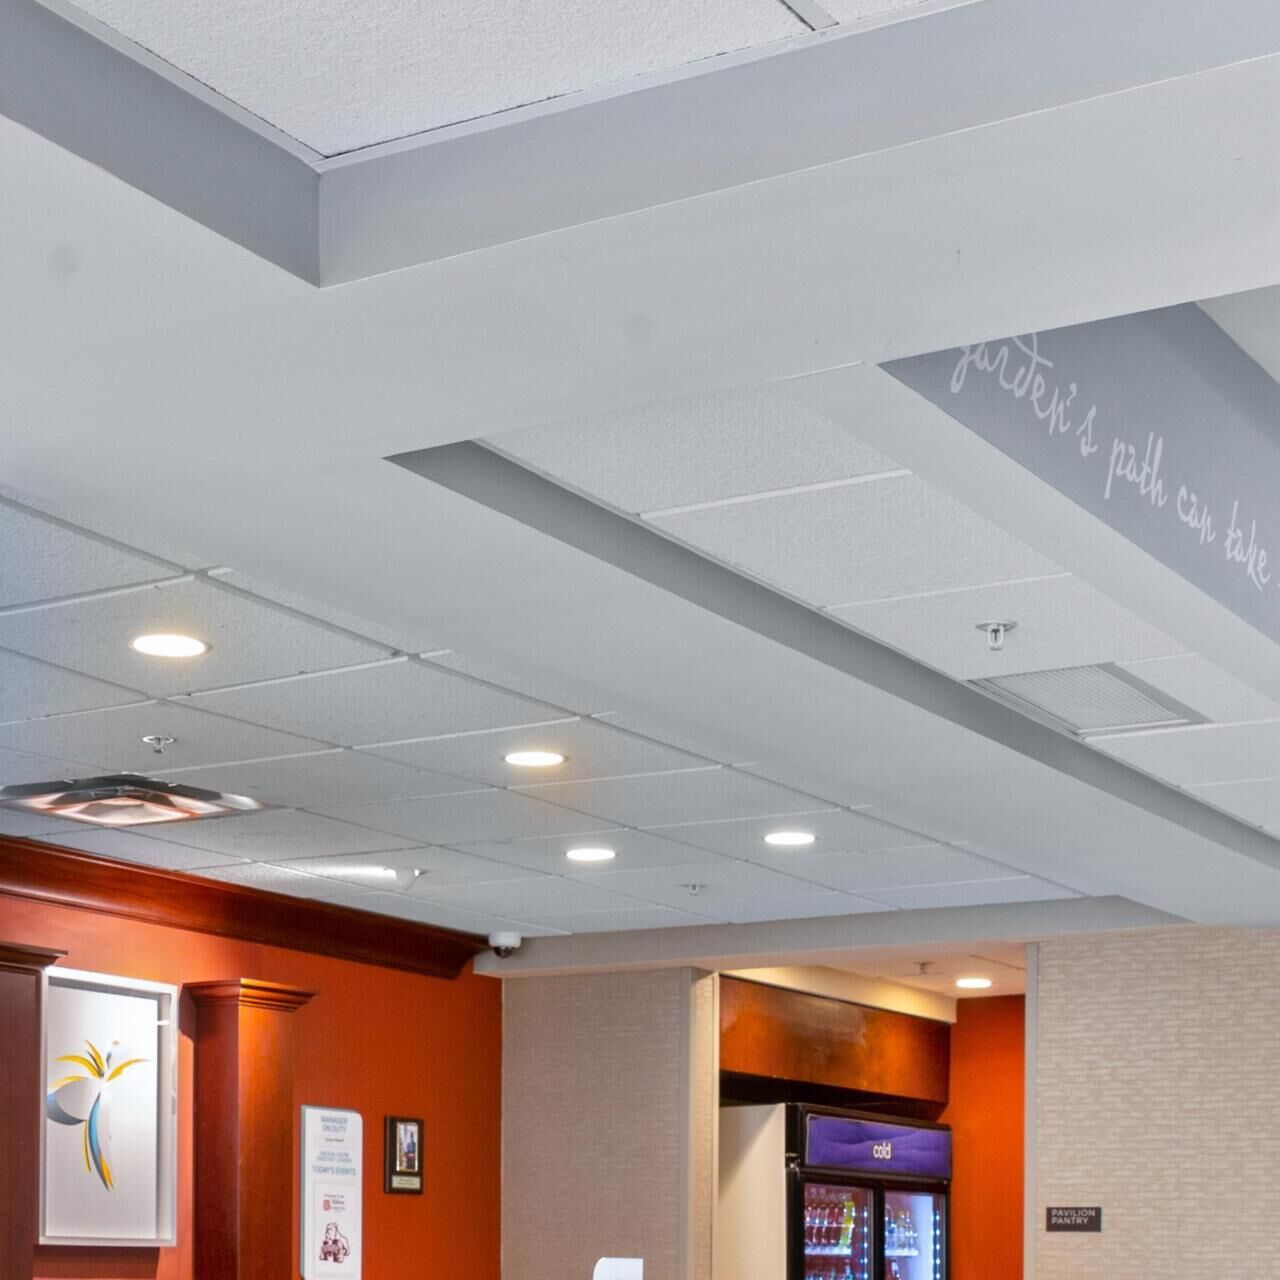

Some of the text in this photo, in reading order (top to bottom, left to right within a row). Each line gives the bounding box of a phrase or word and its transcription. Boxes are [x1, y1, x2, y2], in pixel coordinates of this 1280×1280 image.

[1104, 432, 1167, 507] path
[1177, 485, 1216, 545] can
[1224, 500, 1271, 591] take
[873, 1141, 892, 1159] cold
[1051, 1208, 1096, 1217] PAVILION
[1051, 1216, 1089, 1225] PANTRY
